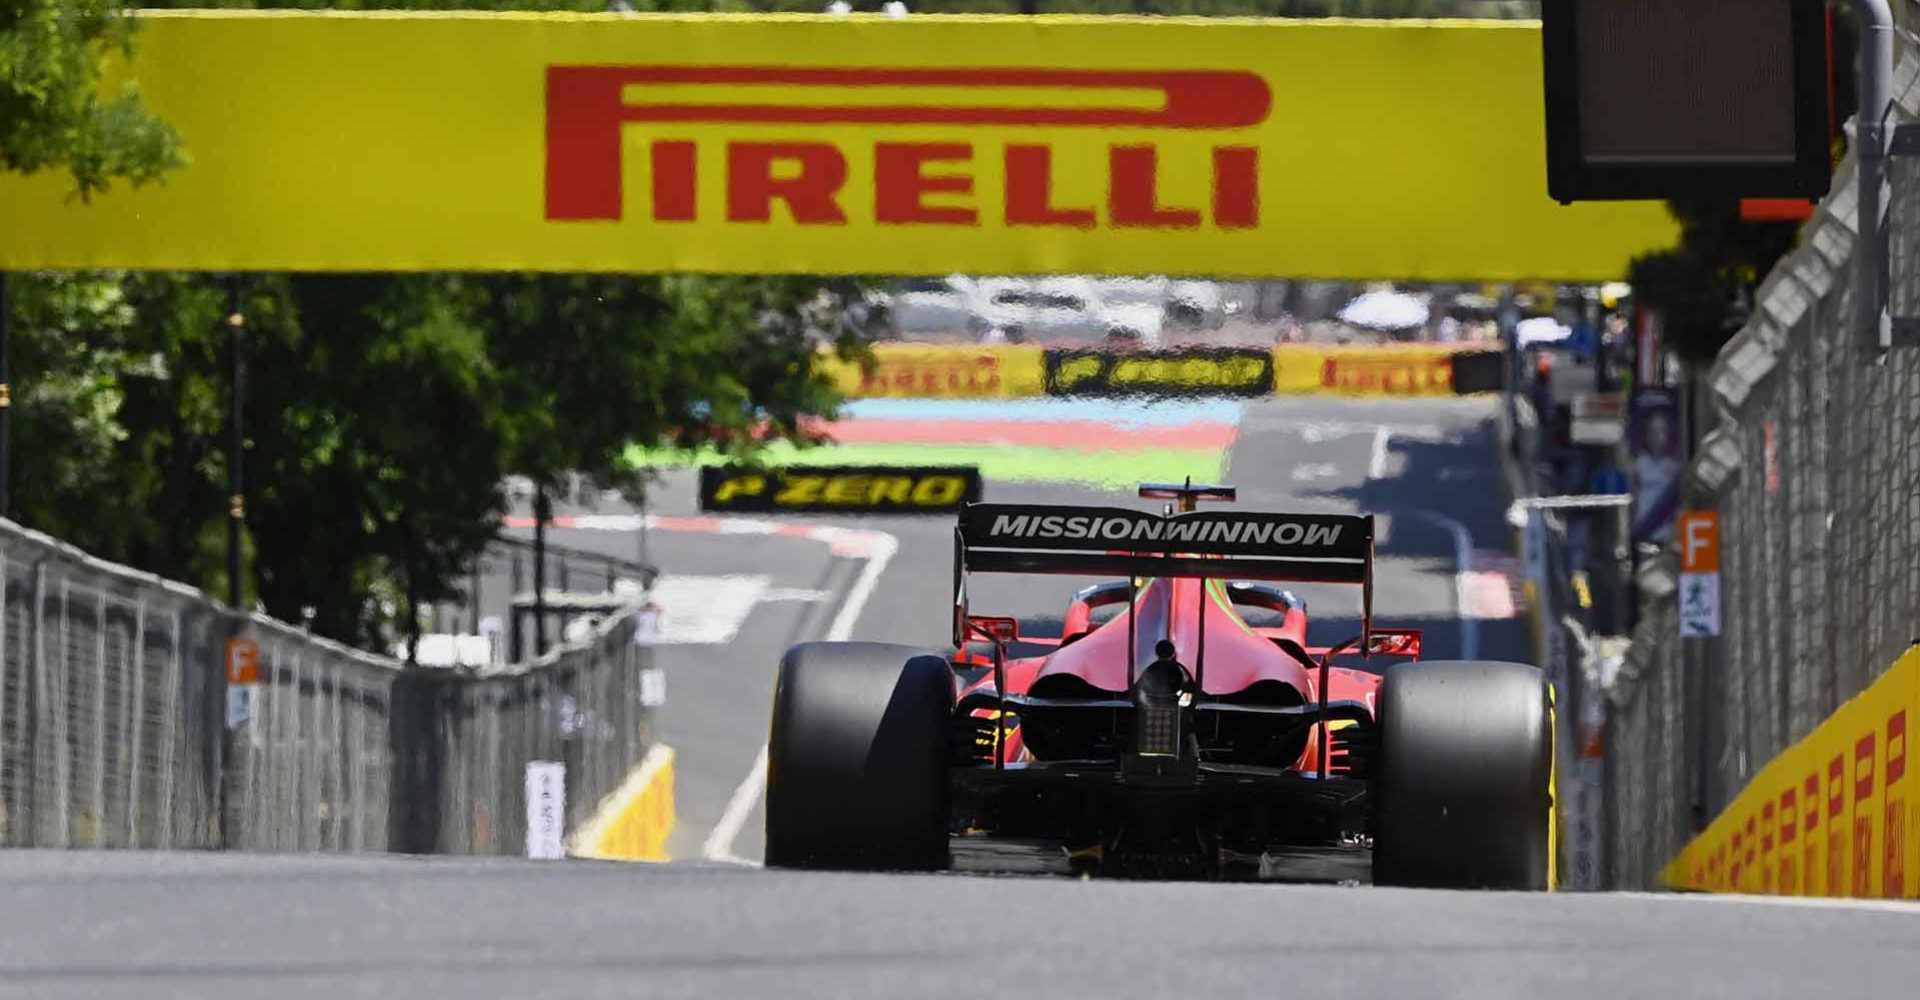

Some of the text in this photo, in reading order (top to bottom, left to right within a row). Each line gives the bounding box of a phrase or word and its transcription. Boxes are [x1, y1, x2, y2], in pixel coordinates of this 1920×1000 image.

[545, 64, 1273, 230] PIRELLI
[715, 474, 968, 505] P ZERO
[1686, 519, 1713, 566] F
